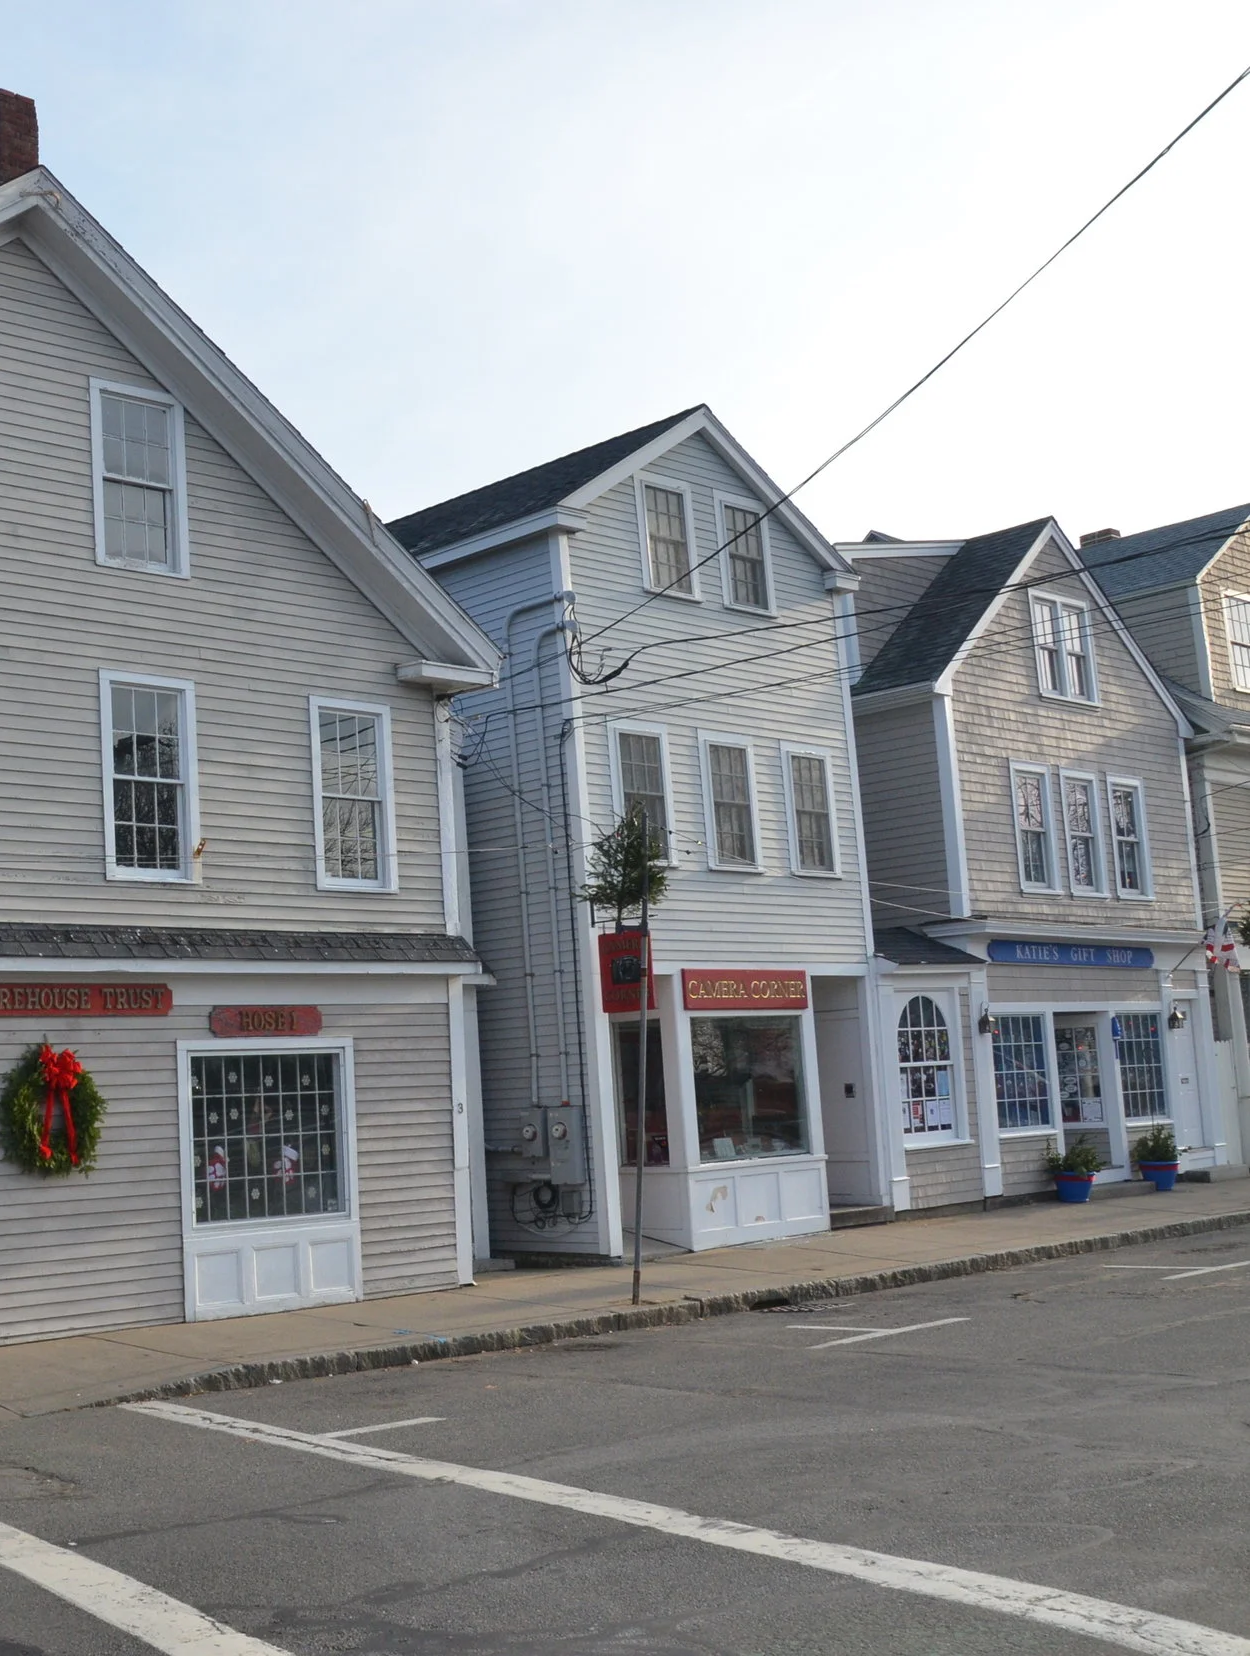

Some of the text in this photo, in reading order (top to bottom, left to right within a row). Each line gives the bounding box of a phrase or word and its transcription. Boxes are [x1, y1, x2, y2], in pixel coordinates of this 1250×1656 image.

[1015, 944, 1133, 964] KATIE'S GIFT SHOP
[100, 988, 165, 1011] TRUST
[688, 980, 806, 999] CAMERA CORNER
[239, 1010, 286, 1032] HOSE
[457, 1103, 464, 1114] 3
